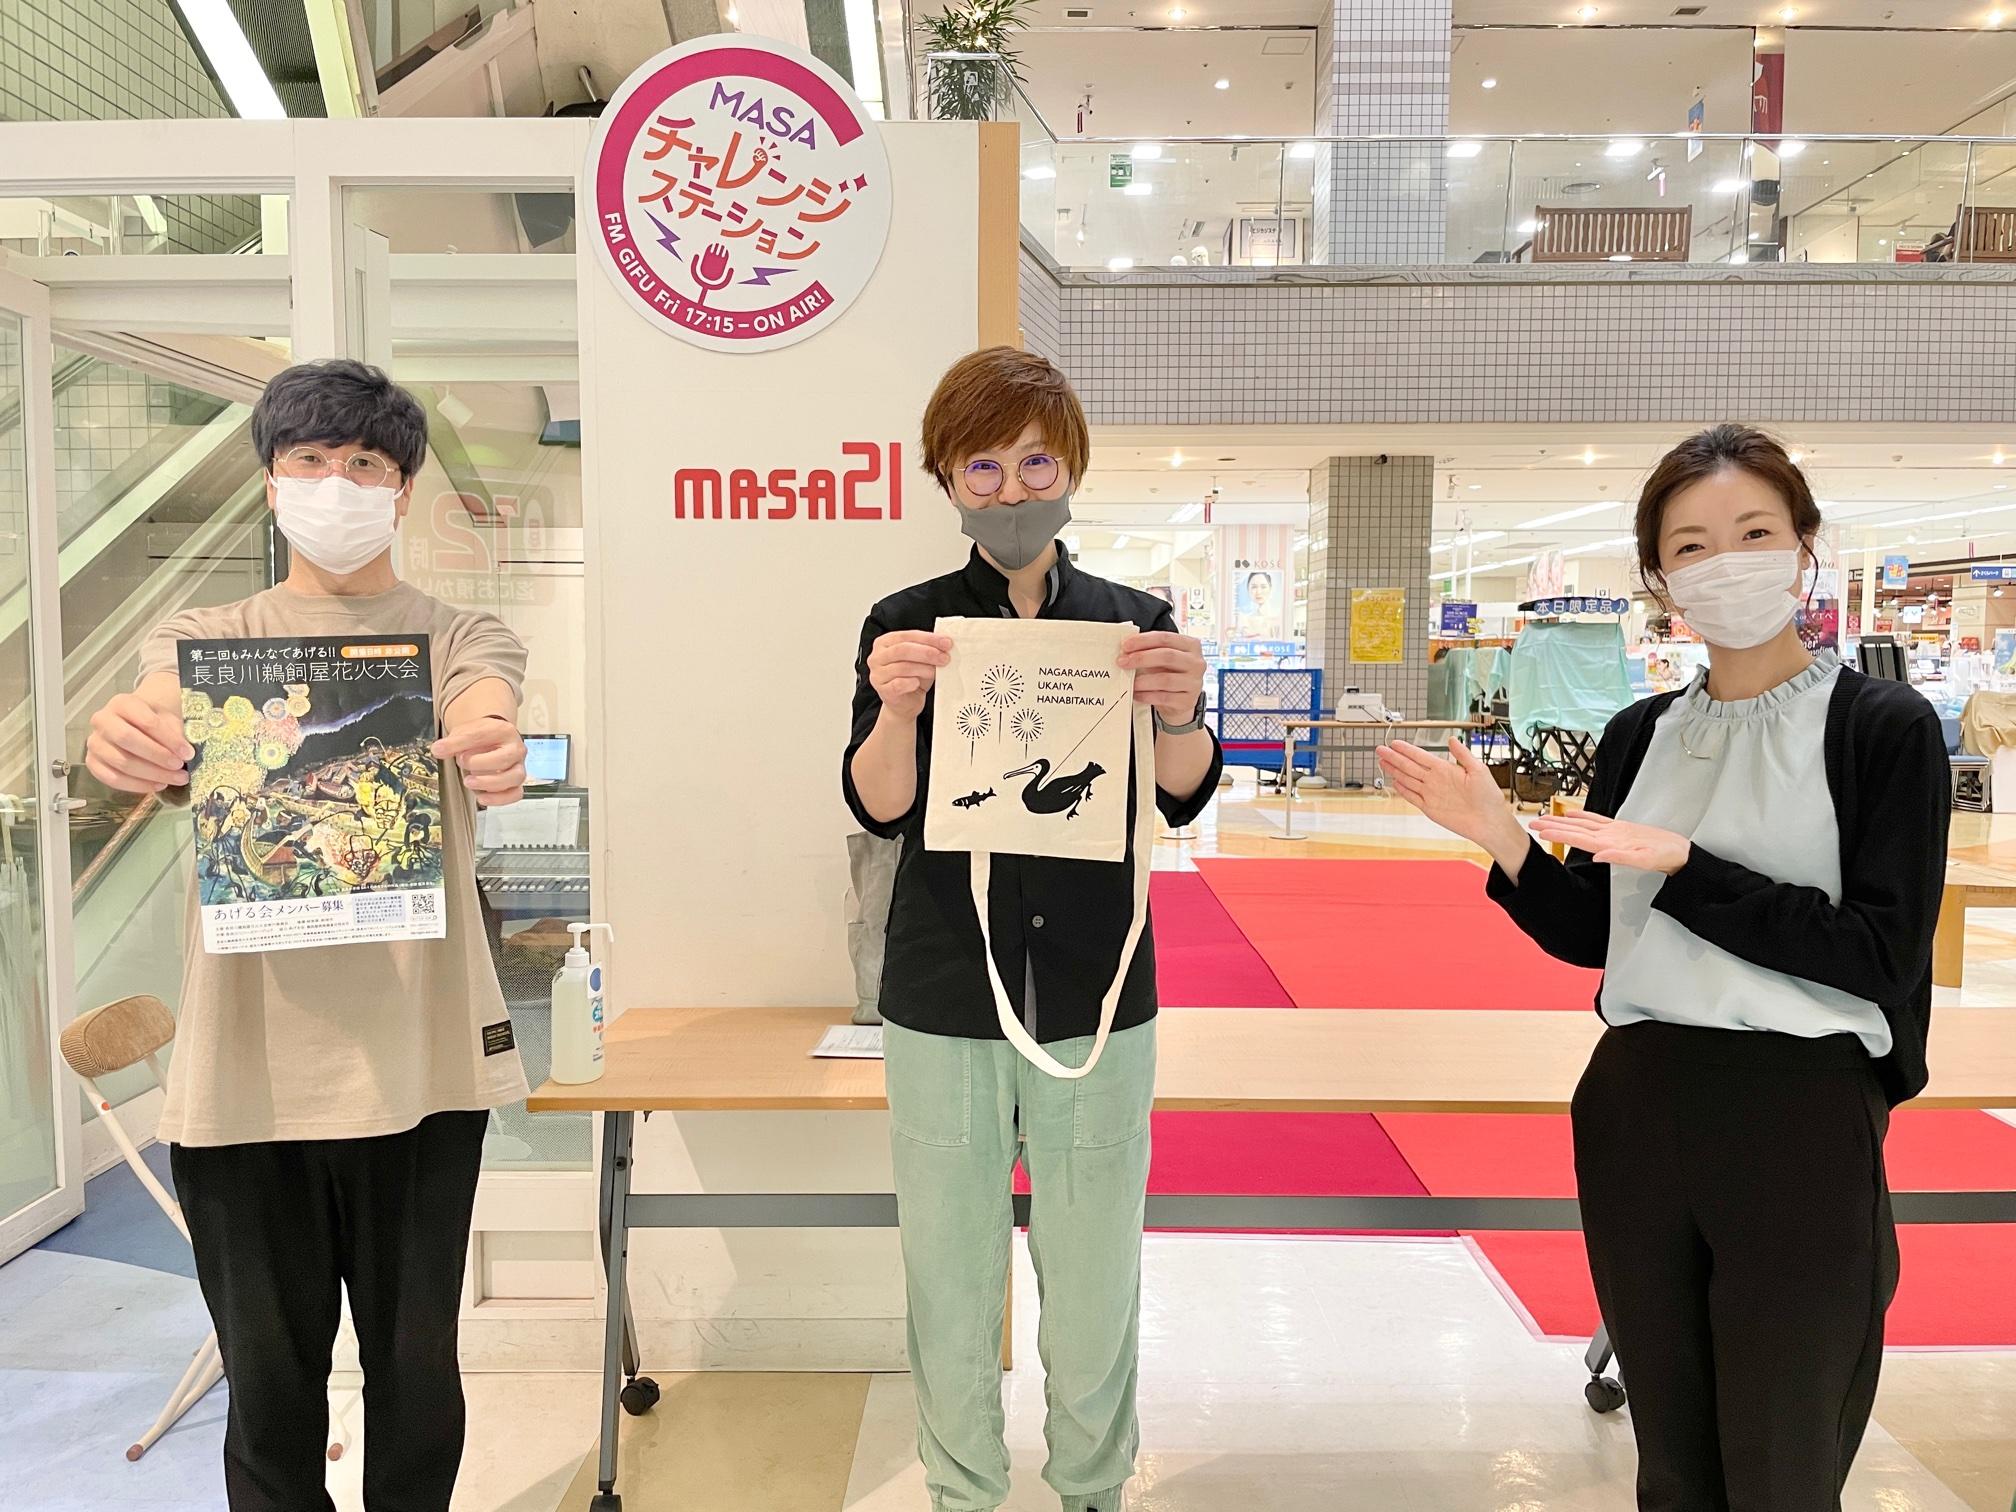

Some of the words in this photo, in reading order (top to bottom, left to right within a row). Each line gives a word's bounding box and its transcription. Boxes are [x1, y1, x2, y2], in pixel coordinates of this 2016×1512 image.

[709, 82, 816, 150] MASA
[643, 115, 851, 223] チャレンジ
[638, 169, 820, 260] ステーション
[604, 211, 622, 245] FM
[618, 247, 657, 292] GIFU
[653, 288, 681, 315] Fri
[685, 307, 735, 333] 17:15
[753, 312, 785, 333] ON
[789, 289, 826, 320] AIR!
[1536, 599, 1613, 614] 本日限定品
[192, 659, 419, 687] 長良川鵜飼屋花火大会
[1038, 667, 1111, 679] NAGARAGAWA
[1037, 681, 1074, 691] UKAIYA
[1036, 695, 1105, 706] HANABITAIKAI
[214, 899, 345, 921] あげる会メンバー募集
